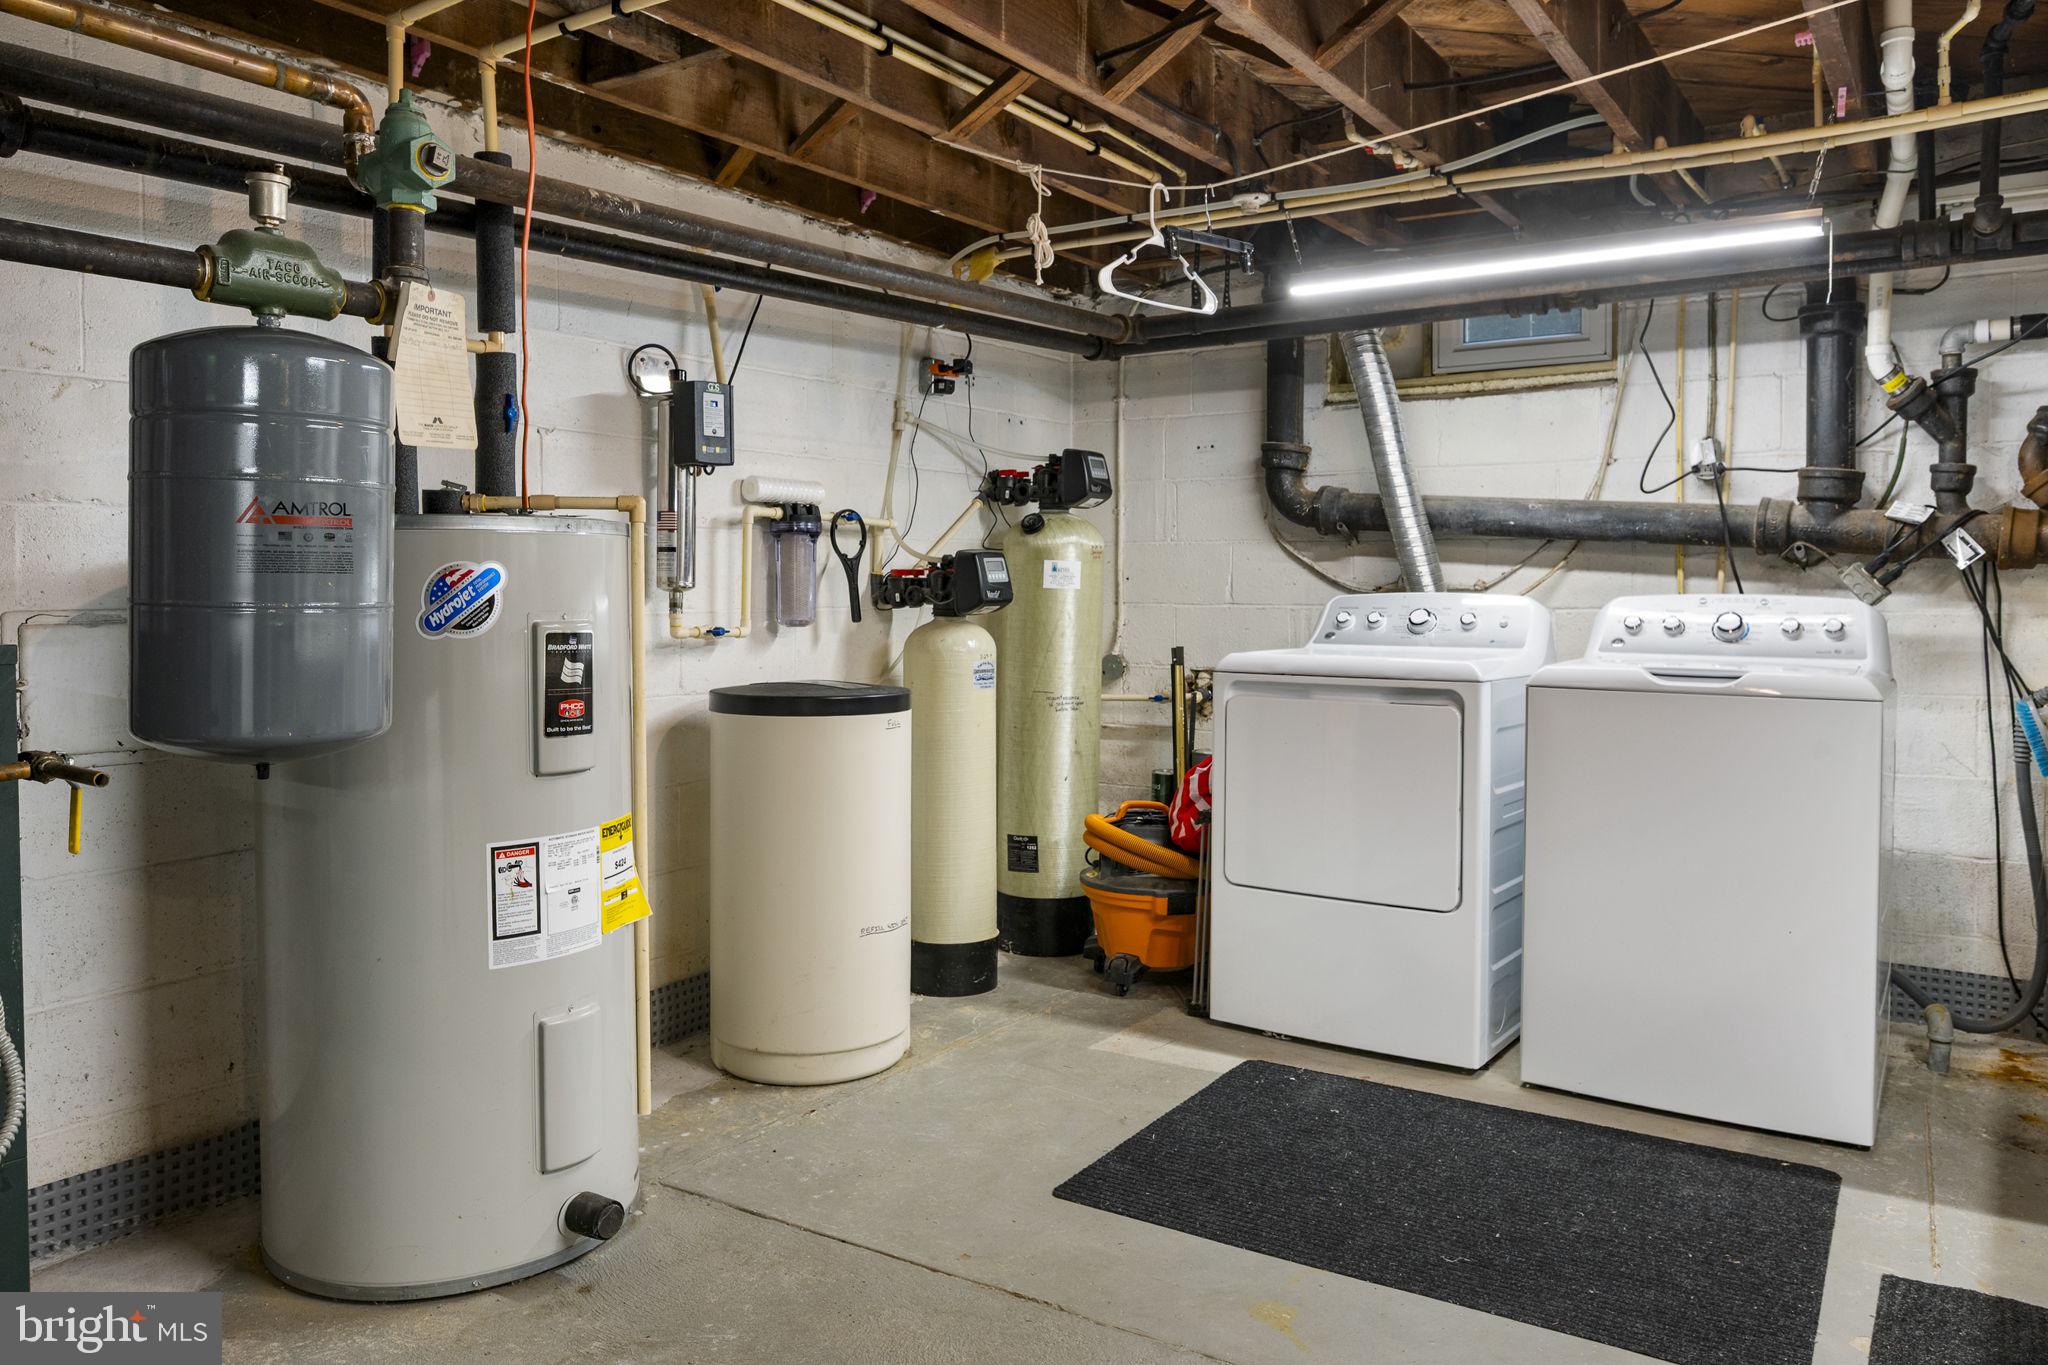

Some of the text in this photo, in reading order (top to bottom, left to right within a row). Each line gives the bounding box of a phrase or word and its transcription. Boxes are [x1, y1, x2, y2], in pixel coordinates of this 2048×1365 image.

[267, 259, 301, 274] TACO
[414, 303, 452, 318] IMPORTANT
[440, 319, 458, 327] REMOVE
[272, 501, 351, 516] AMTROL
[428, 585, 477, 628] Hydrojet
[560, 702, 584, 710] PHCC
[506, 849, 530, 857] DANGER
